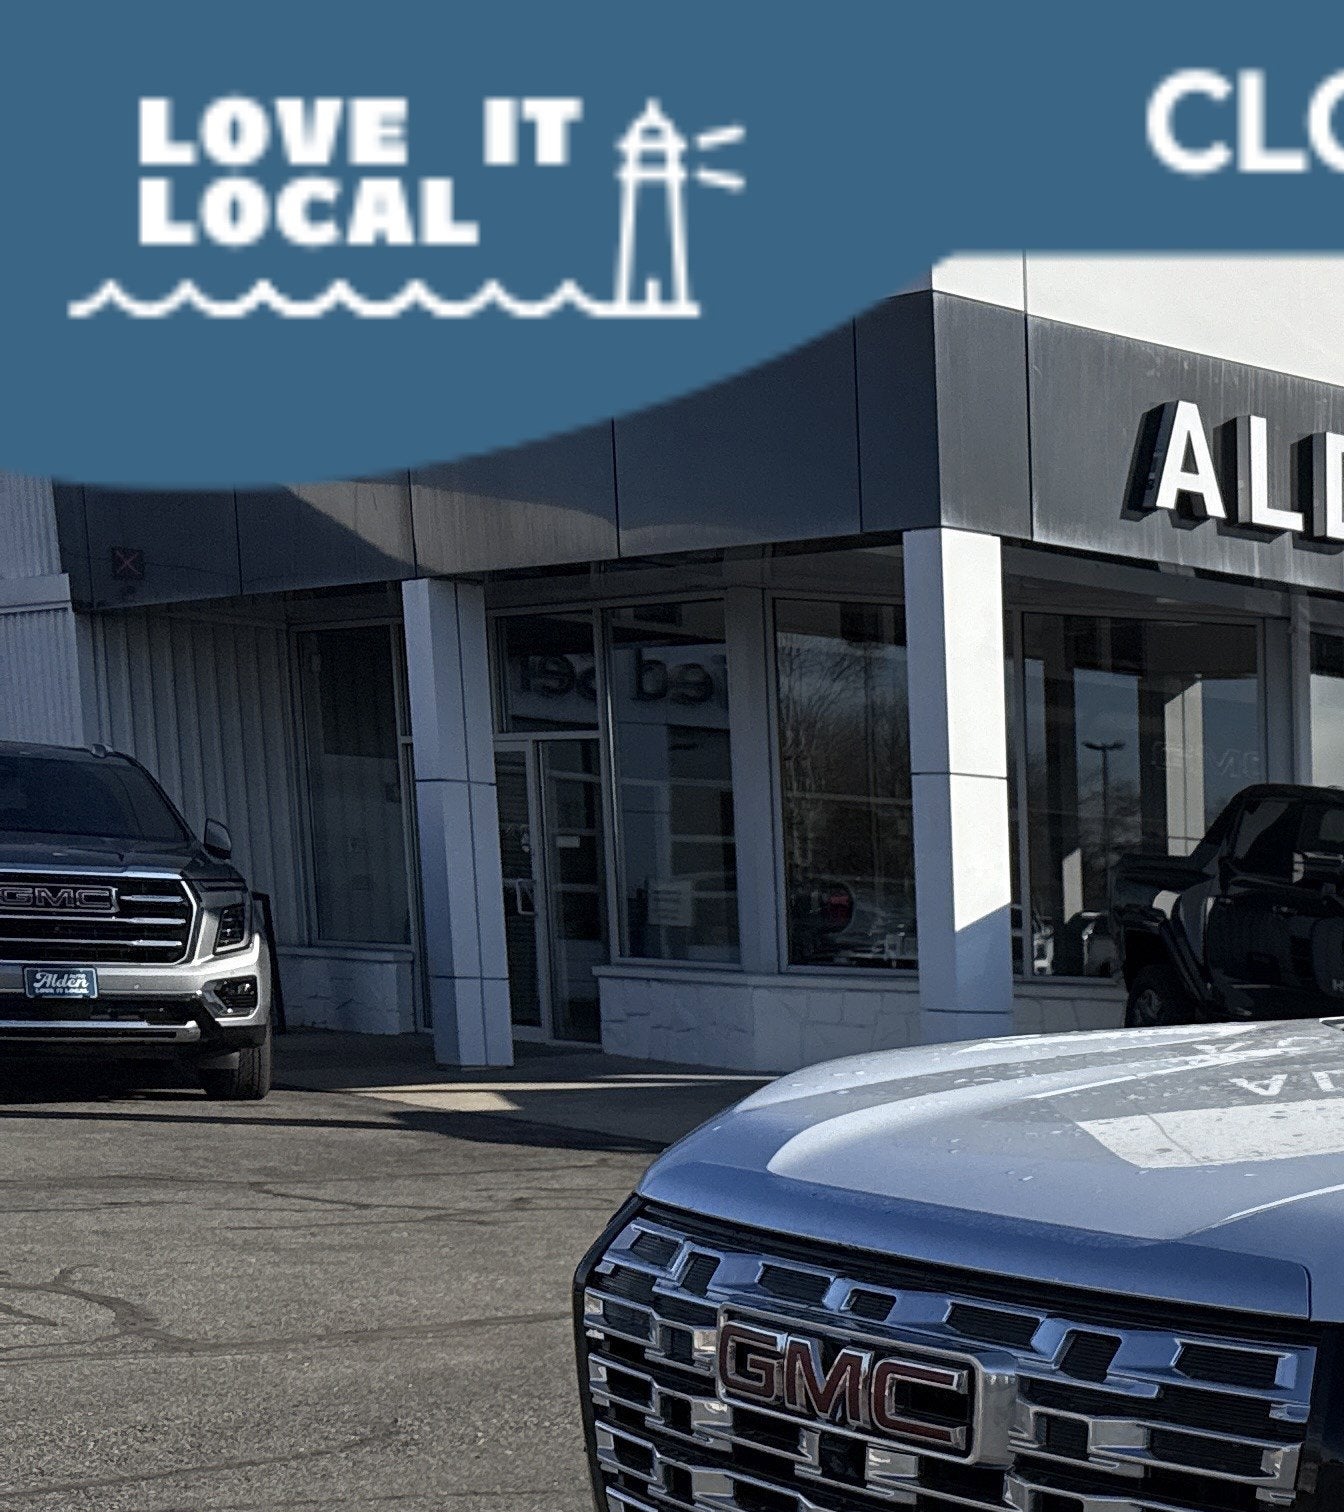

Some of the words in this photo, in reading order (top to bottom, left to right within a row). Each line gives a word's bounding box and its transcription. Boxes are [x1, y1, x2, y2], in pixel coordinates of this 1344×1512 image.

[0, 886, 111, 908] GMC
[33, 972, 90, 988] Alden
[718, 1319, 968, 1451] GMC
